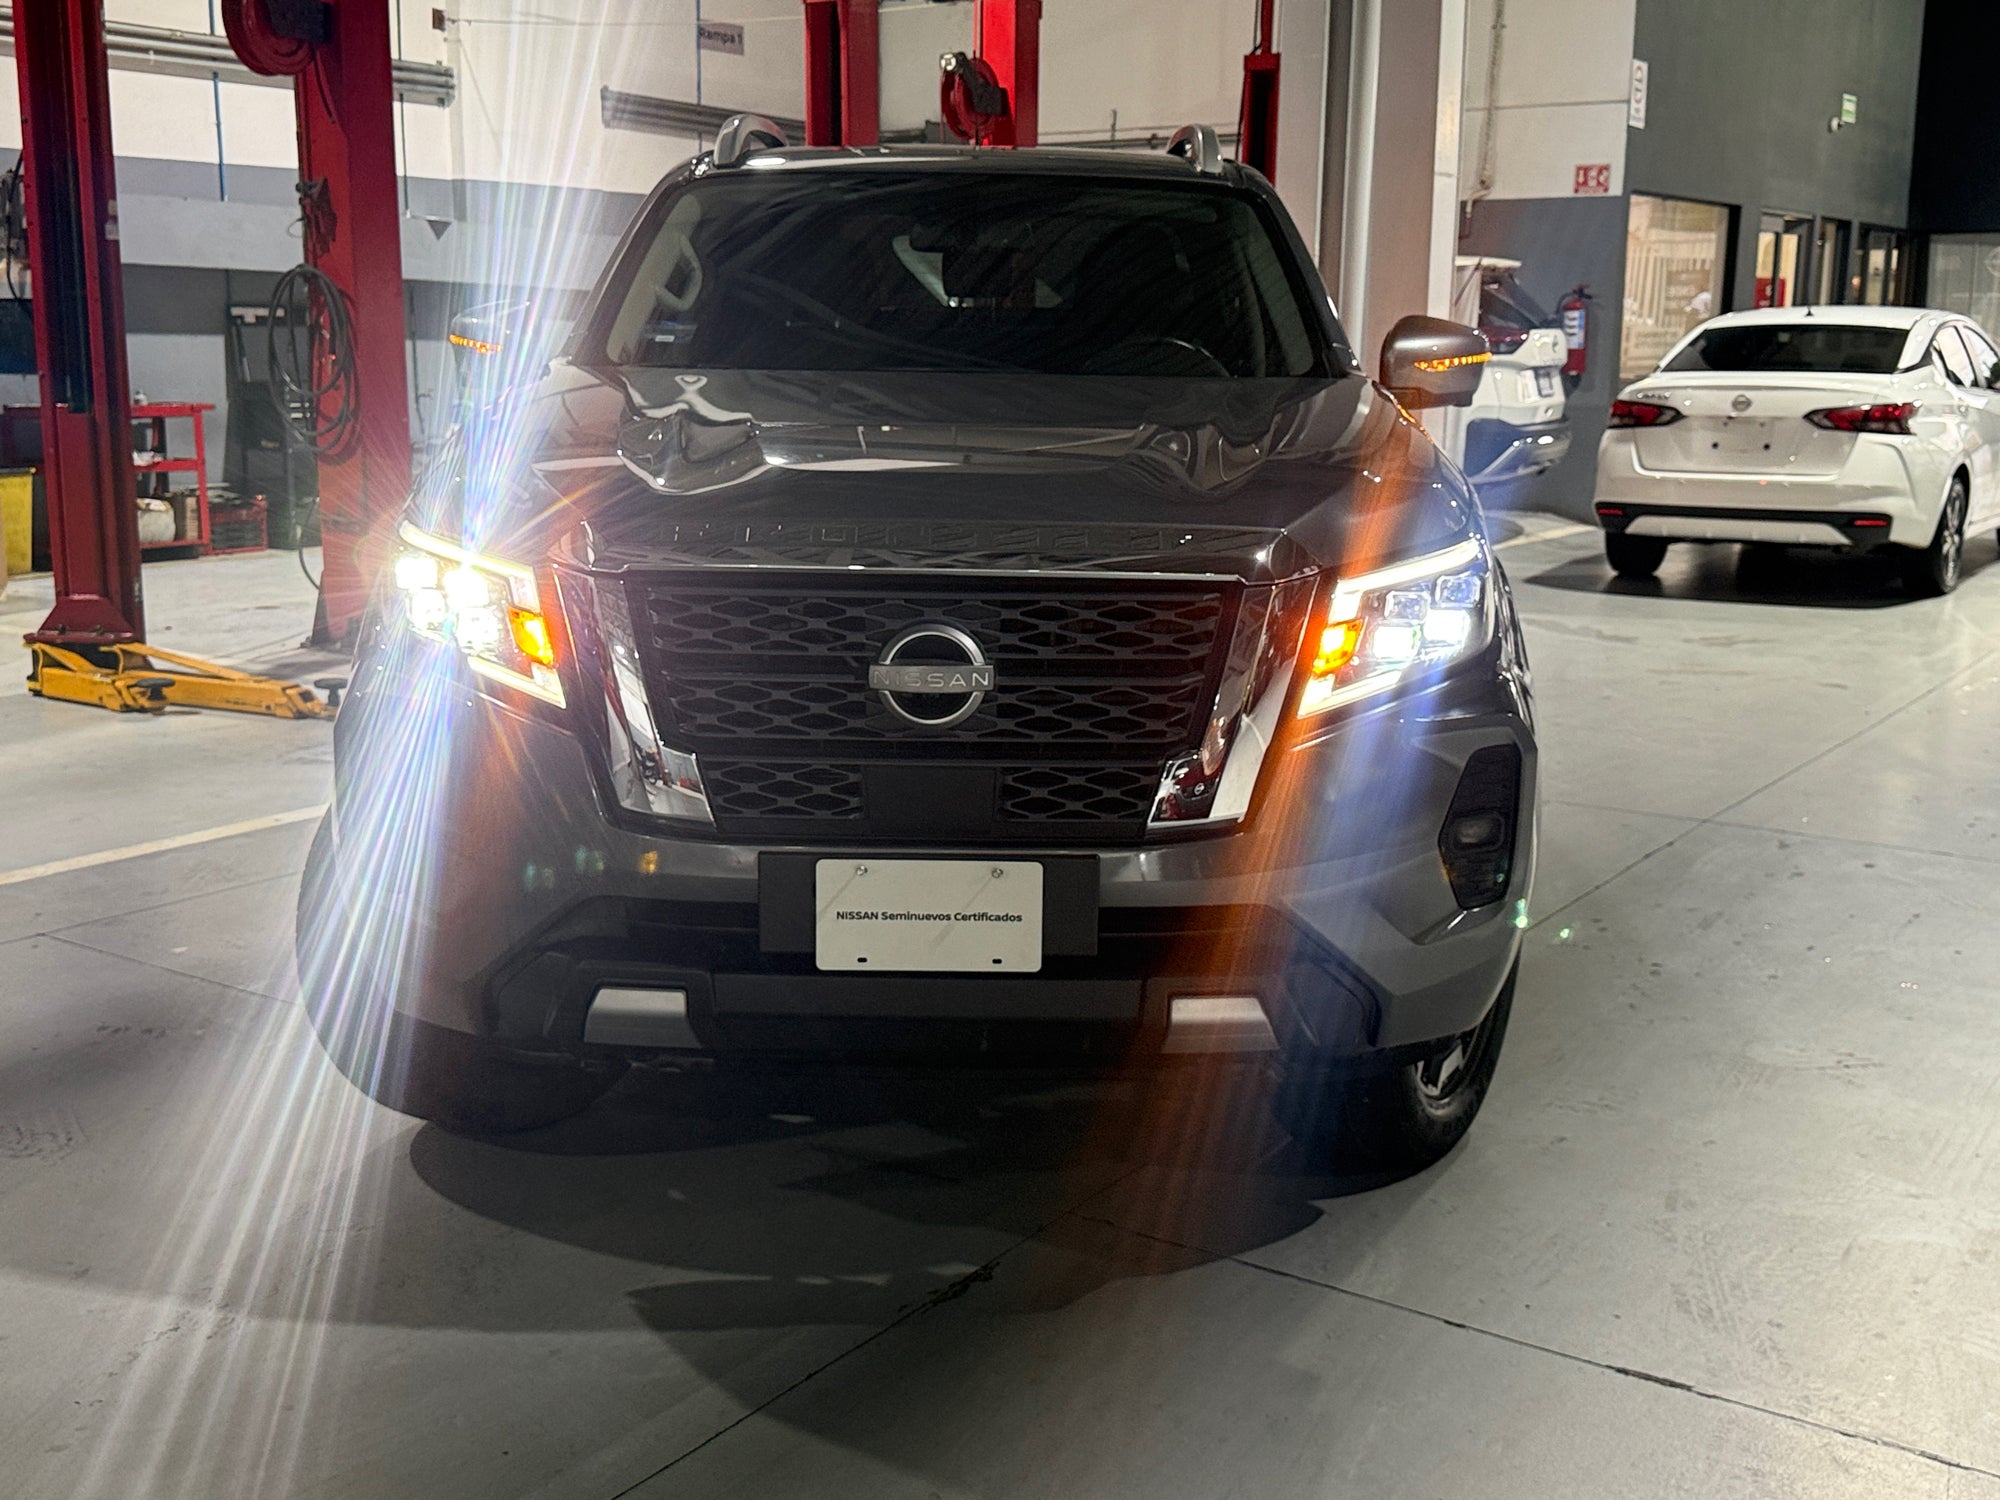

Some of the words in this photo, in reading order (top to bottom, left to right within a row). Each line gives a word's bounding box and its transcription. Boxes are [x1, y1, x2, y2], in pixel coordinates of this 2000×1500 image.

[873, 671, 989, 687] NISSAN
[836, 910, 879, 921] NISSAN
[881, 910, 952, 922] Seminuevos
[953, 911, 1023, 923] Certificados
